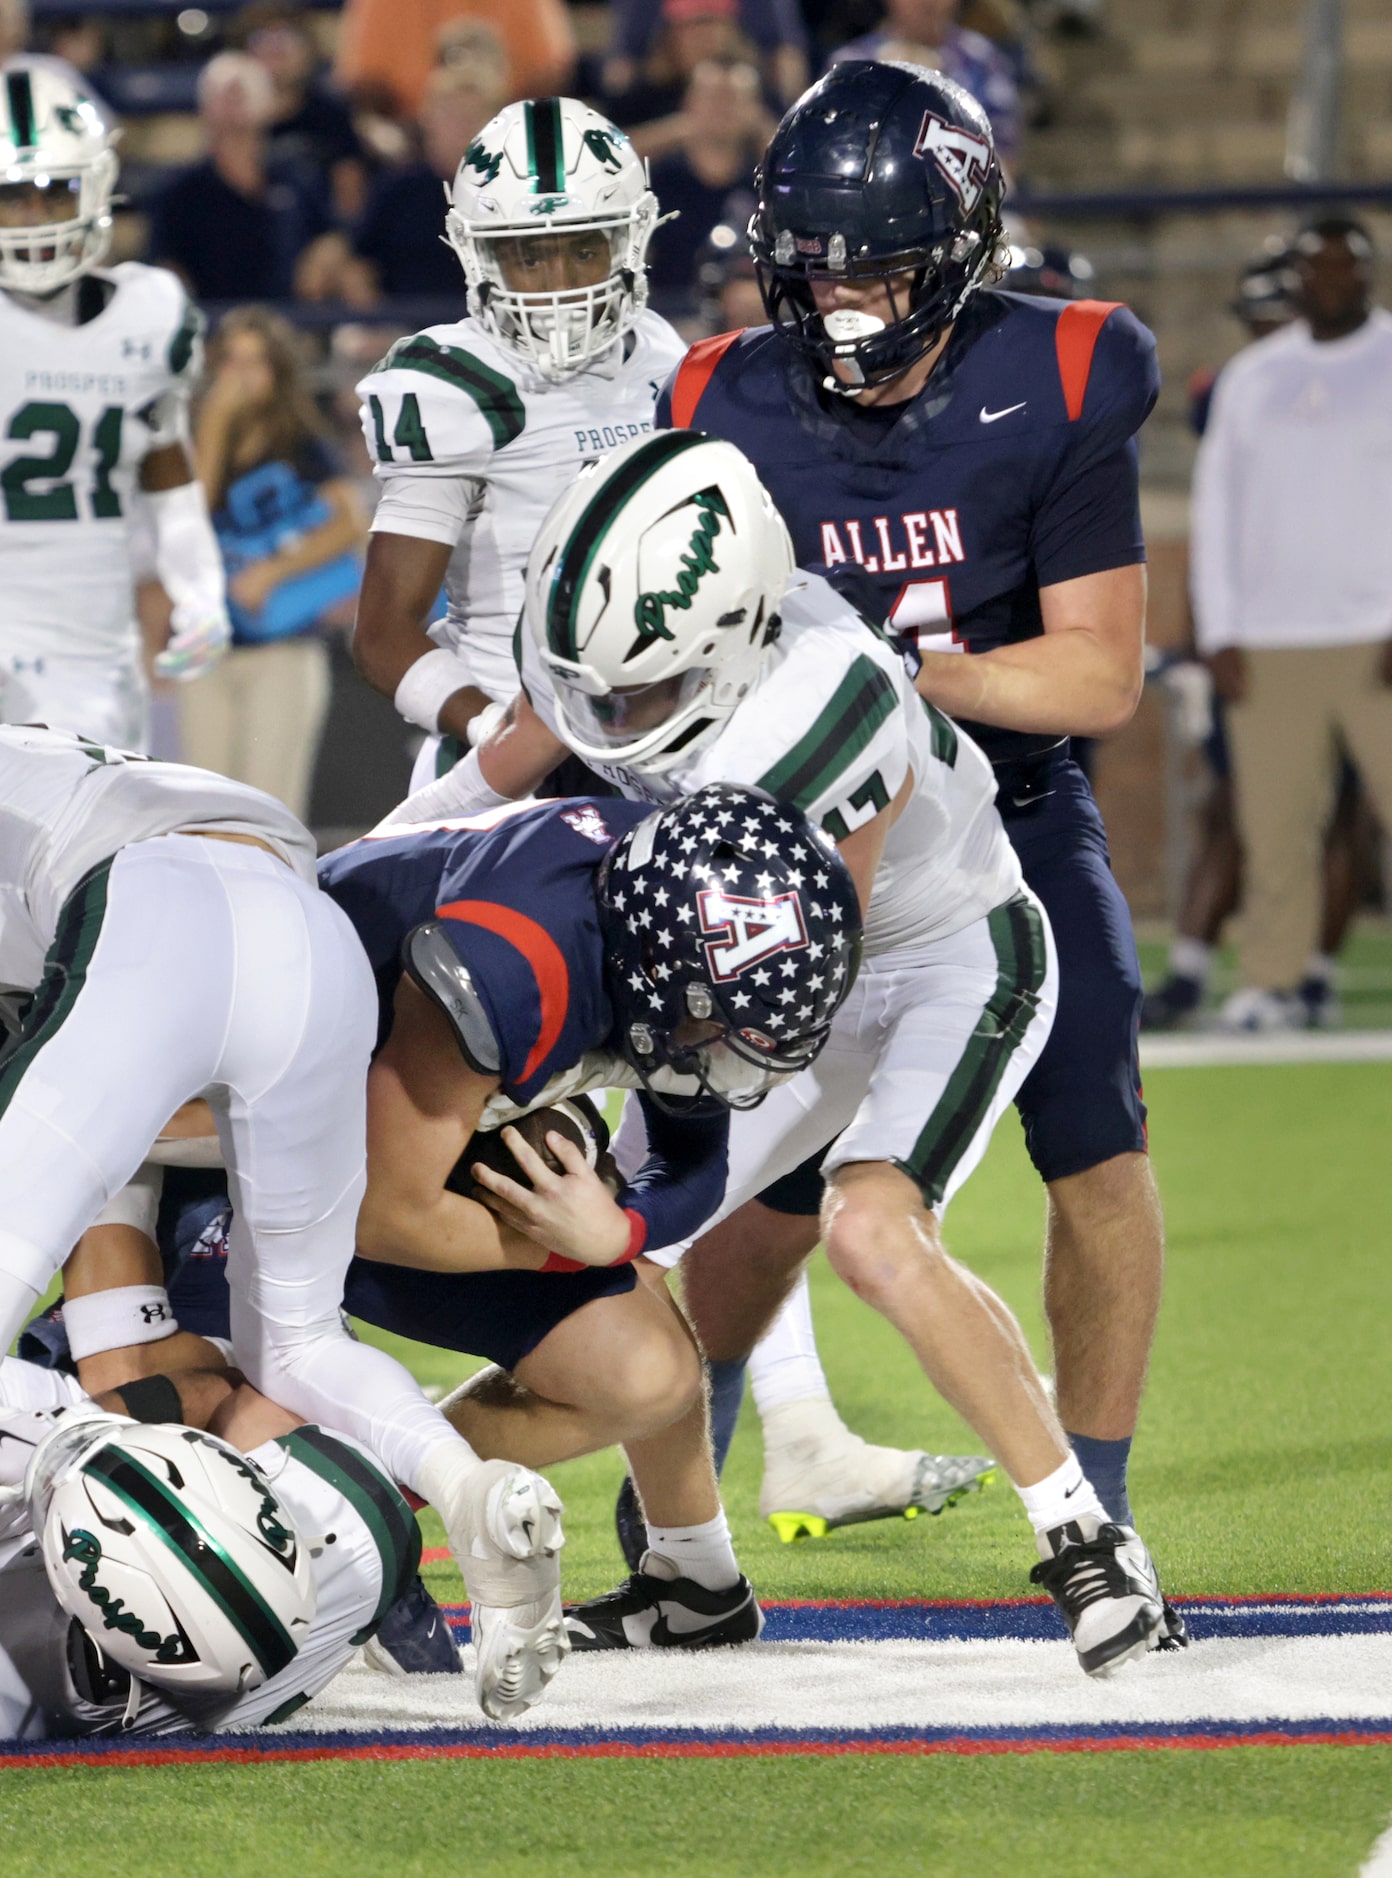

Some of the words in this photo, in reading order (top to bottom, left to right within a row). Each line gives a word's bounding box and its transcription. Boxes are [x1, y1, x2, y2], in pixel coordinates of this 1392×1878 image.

[368, 392, 434, 462] 14
[574, 421, 651, 452] PROSPE
[634, 493, 730, 641] Prosper
[820, 507, 966, 574] ALLEN
[696, 887, 810, 985] A
[62, 1527, 182, 1663] Prosper
